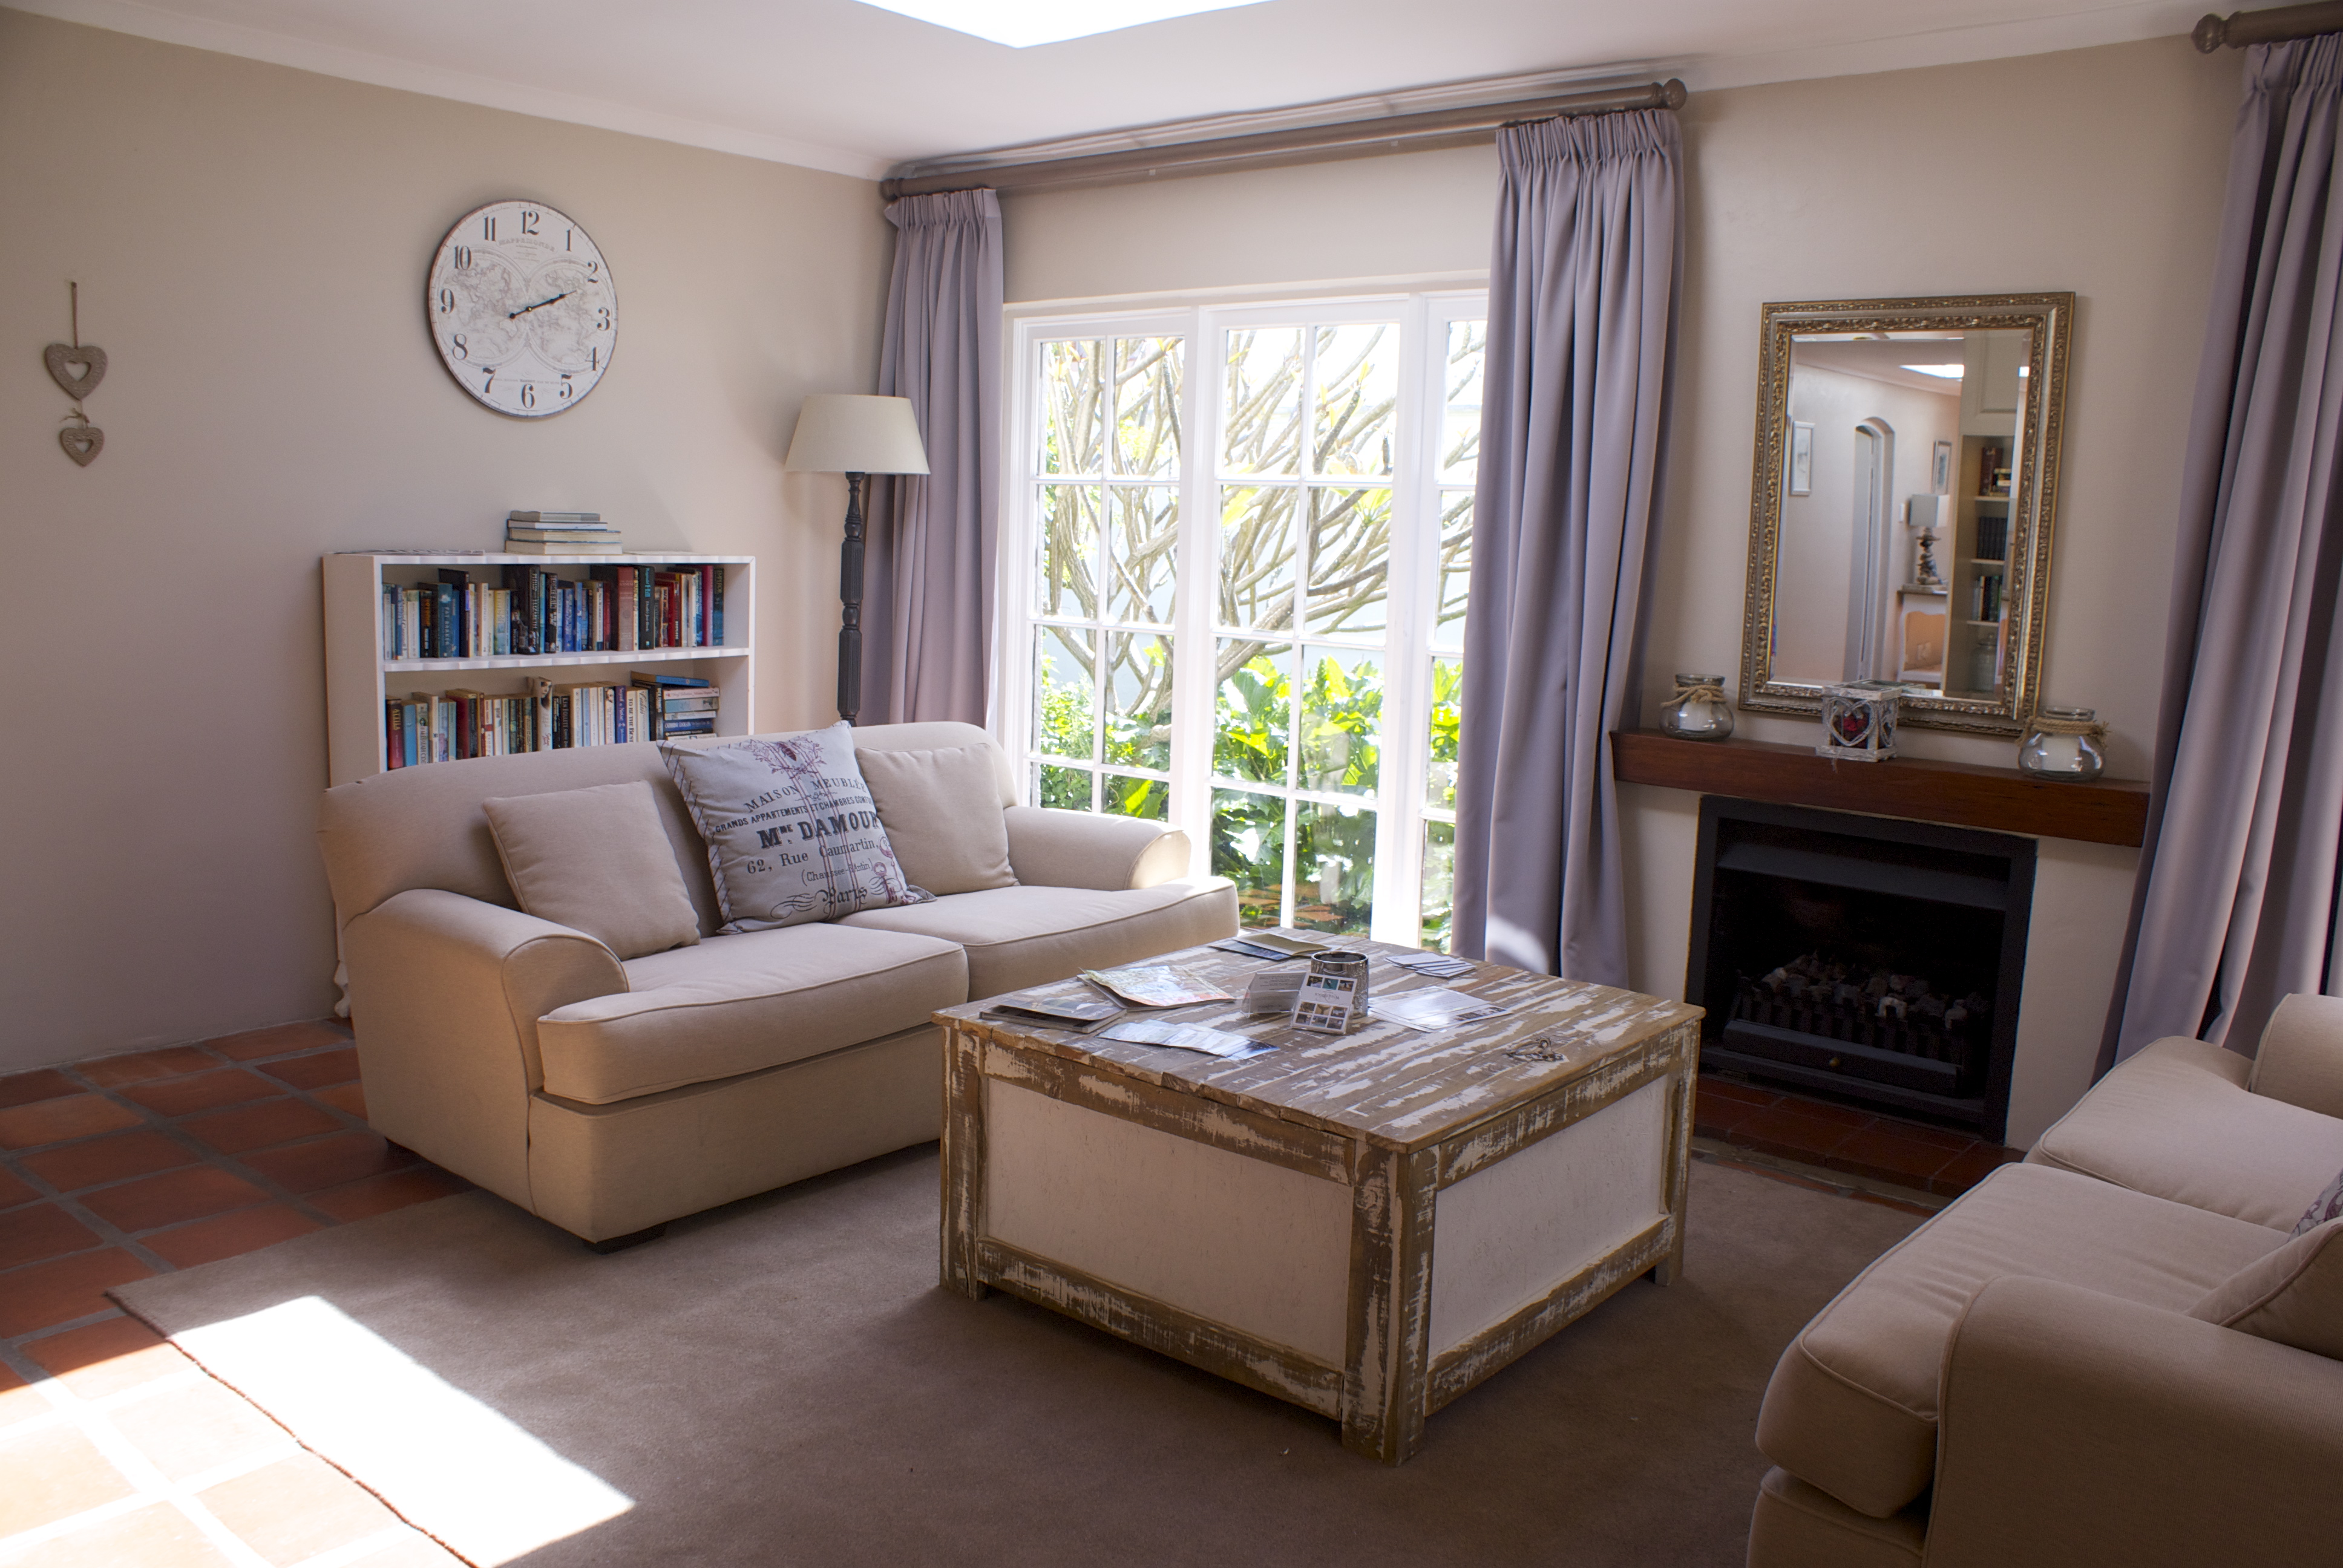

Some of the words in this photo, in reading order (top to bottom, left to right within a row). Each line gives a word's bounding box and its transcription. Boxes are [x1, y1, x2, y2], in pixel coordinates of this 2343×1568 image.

[484, 216, 496, 241] 11
[521, 211, 540, 235] 12
[566, 229, 572, 252] 1
[454, 245, 472, 270] 10
[587, 261, 598, 284] 2
[441, 289, 454, 314] 9
[597, 307, 611, 331] 3
[452, 333, 468, 361] 8
[585, 347, 600, 371] 4
[482, 367, 496, 394] 7
[560, 374, 572, 399] 5
[521, 383, 536, 409] 6
[392, 708, 401, 731] ATTILA
[743, 785, 800, 812] MAISON
[715, 817, 749, 833] GRANDS
[751, 806, 808, 826] APPARTEMENTS
[809, 803, 819, 813] ET
[819, 797, 854, 811] CHAMBRES
[797, 811, 880, 842] DAMOUR
[747, 859, 773, 875] 62,
[779, 852, 809, 867] Rue
